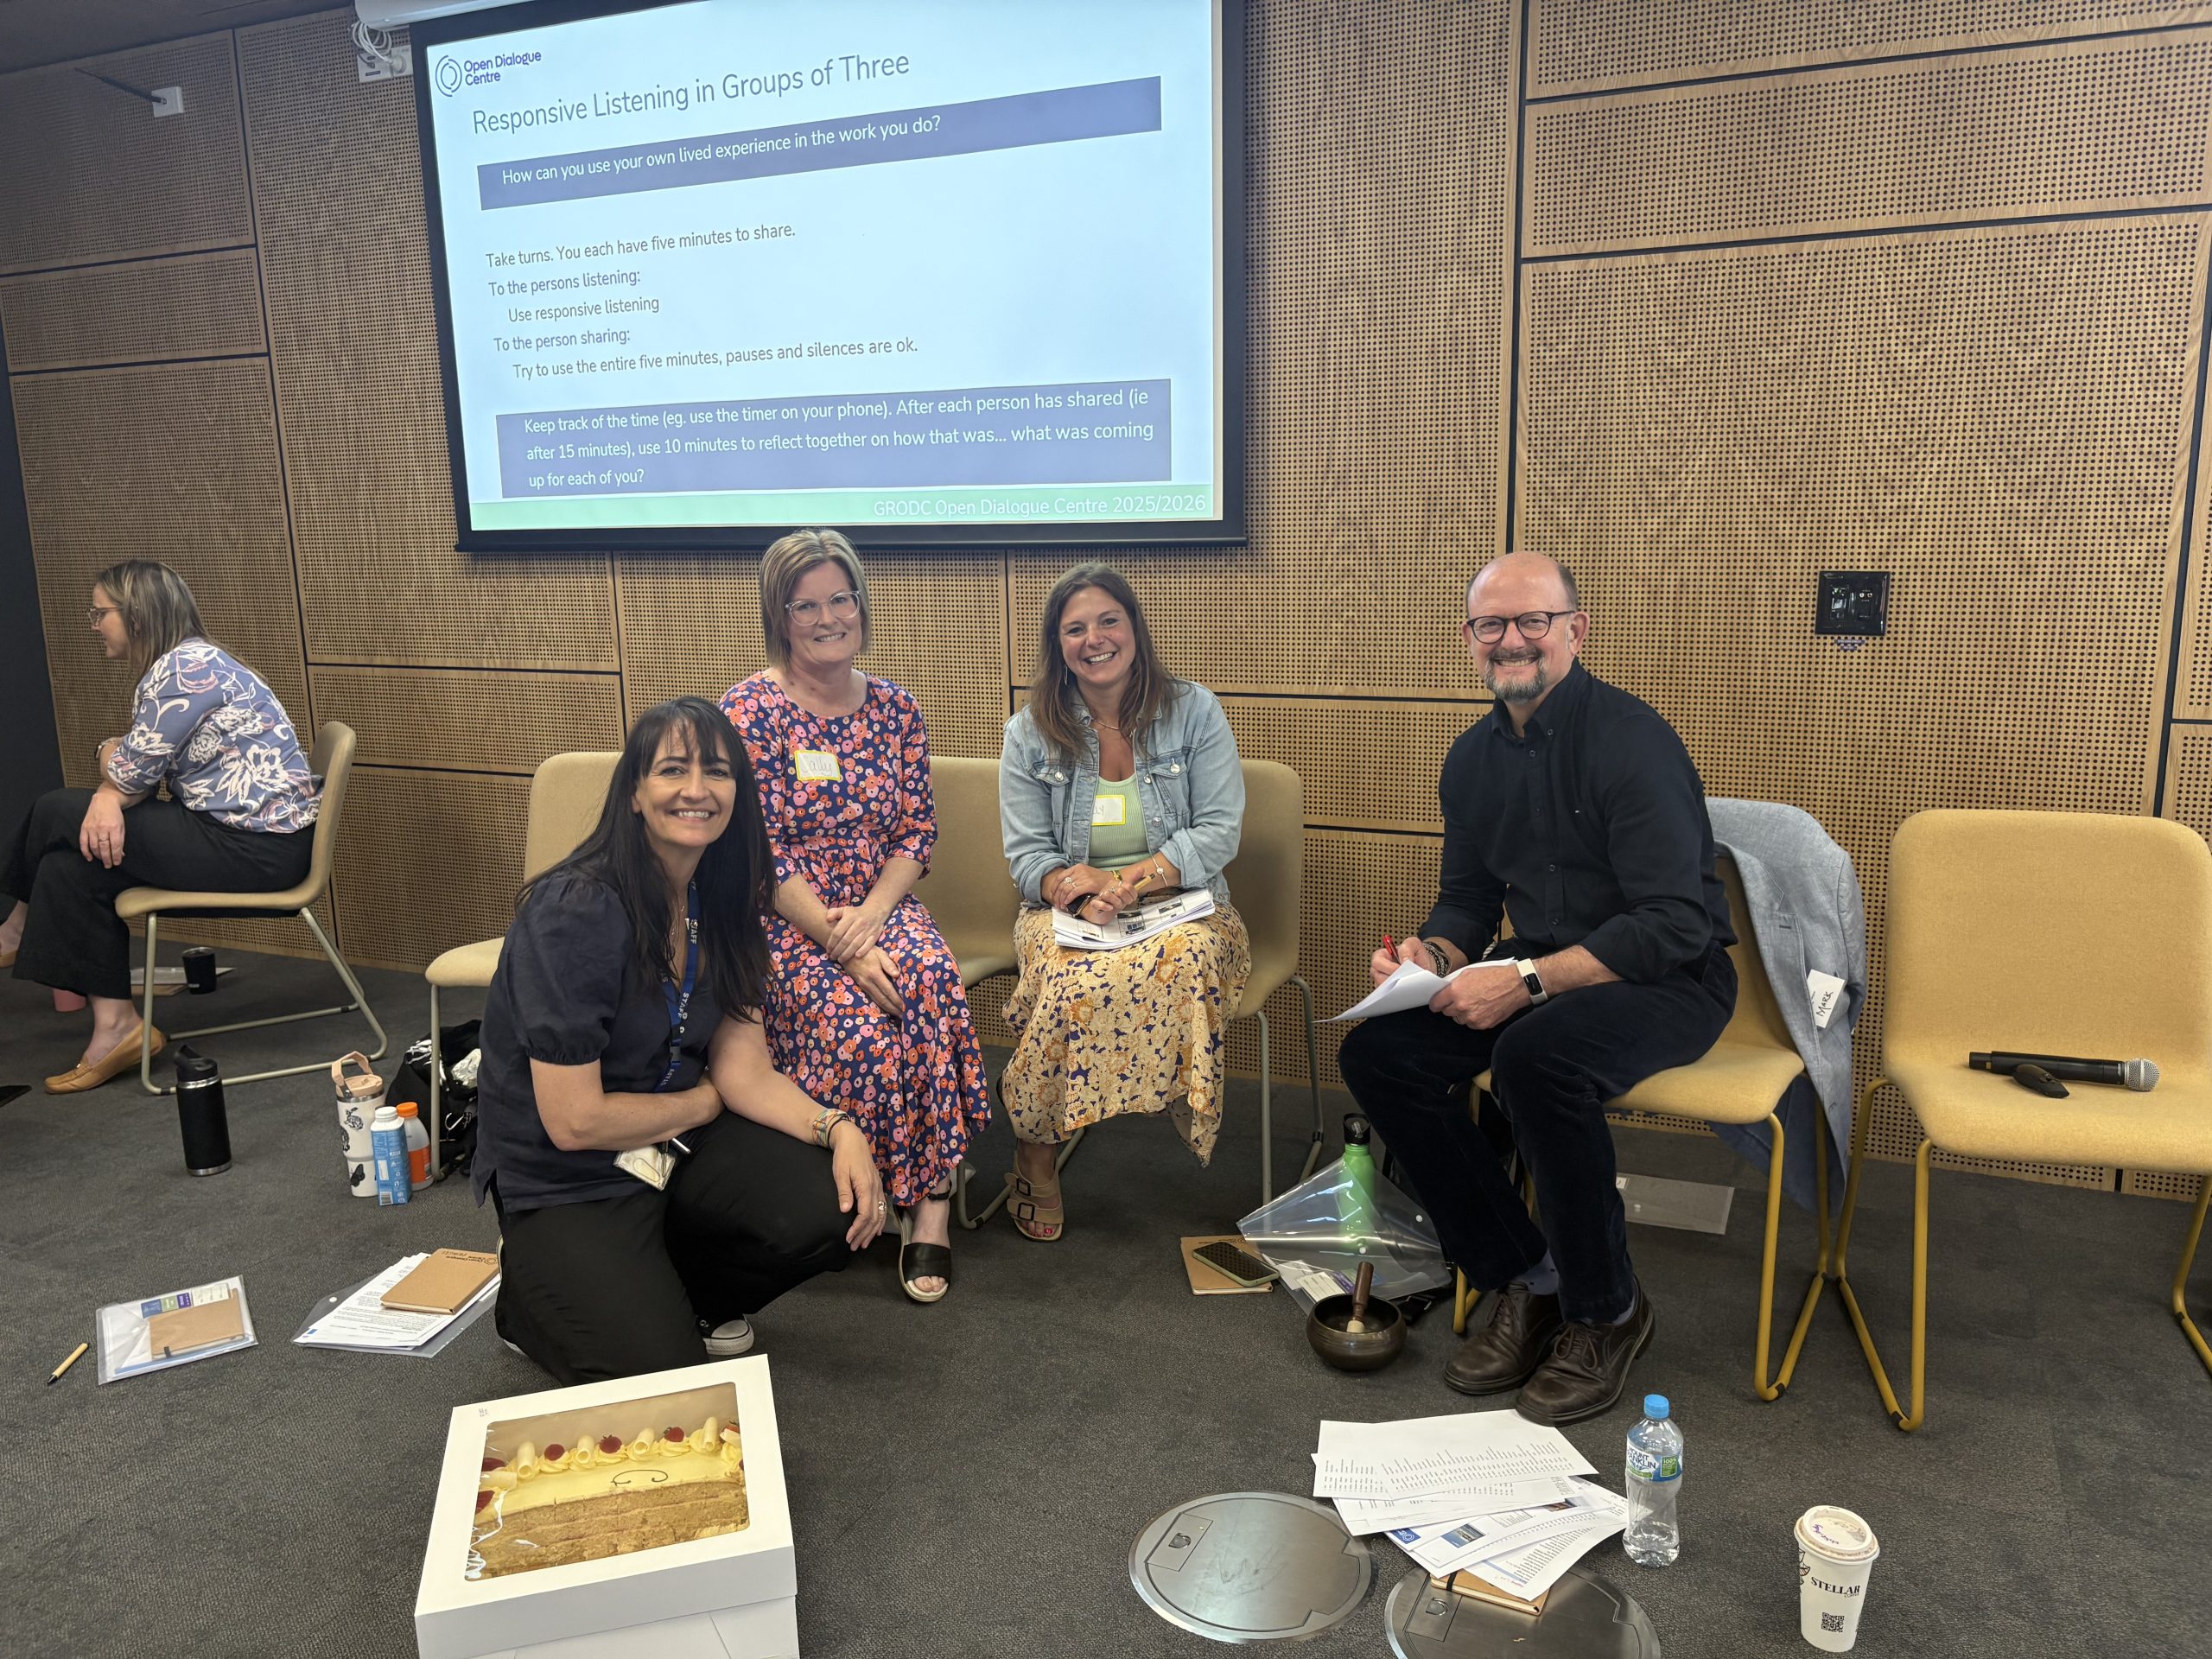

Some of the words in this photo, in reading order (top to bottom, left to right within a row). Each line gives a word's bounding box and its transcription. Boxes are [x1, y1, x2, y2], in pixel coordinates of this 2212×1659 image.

[464, 60, 493, 74] Open
[495, 50, 542, 67] Dialogue
[465, 71, 501, 86] Centre
[474, 99, 588, 134] Responsive
[594, 84, 689, 117] Listening
[696, 79, 715, 102] in
[722, 69, 804, 99] Groups
[811, 59, 834, 86] of
[838, 54, 910, 82] Three
[503, 168, 532, 185] How
[536, 168, 558, 180] can
[561, 164, 585, 181] you
[588, 161, 611, 173] use
[613, 156, 644, 175] your
[647, 152, 675, 166] own
[679, 144, 712, 163] lived
[715, 137, 791, 161] experience
[795, 132, 808, 149] in
[810, 129, 836, 145] the
[839, 123, 876, 143] work
[880, 121, 908, 142] you
[912, 115, 941, 133] do?
[486, 251, 516, 268] Take
[518, 251, 554, 264] turns.
[556, 245, 581, 261] You
[584, 241, 613, 258] each
[617, 239, 649, 255] have
[651, 235, 676, 251] five
[679, 230, 733, 248] minutes
[735, 227, 750, 243] to
[753, 223, 796, 240] share.
[488, 282, 505, 296] To
[507, 279, 528, 295] the
[531, 277, 580, 296] persons
[582, 270, 641, 288] listening:
[508, 308, 532, 323] Use
[536, 302, 602, 323] responsive
[605, 296, 660, 315] listening
[493, 338, 510, 353] To
[512, 335, 532, 351] the
[536, 334, 577, 353] person
[581, 328, 631, 346] sharing:
[512, 364, 533, 381] Try
[536, 363, 549, 378] to
[551, 362, 574, 376] use
[576, 359, 597, 374] the
[600, 355, 637, 372] entire
[639, 353, 663, 370] five
[666, 350, 722, 368] minutes,
[726, 349, 773, 366] pauses
[777, 343, 804, 359] and
[807, 341, 864, 358] silences
[868, 340, 893, 354] are
[896, 336, 918, 353] ok.
[524, 418, 556, 435] Keep
[557, 416, 588, 431] track
[591, 414, 605, 429] of
[607, 413, 628, 429] the
[630, 411, 659, 427] time
[663, 410, 687, 429] (eg.
[690, 410, 714, 423] use
[715, 407, 739, 422] the
[741, 406, 778, 422] timer
[781, 409, 798, 421] on
[802, 405, 834, 422] your
[837, 400, 893, 420] phone).
[896, 398, 934, 416] After
[938, 396, 972, 414] each
[976, 394, 1030, 415] person
[1034, 391, 1063, 410] has
[1067, 389, 1123, 408] shared
[1128, 389, 1148, 410] (ie
[526, 445, 555, 461] after
[559, 443, 575, 459] 15
[578, 441, 635, 458] minutes),
[639, 442, 661, 455] use
[664, 438, 681, 454] 10
[684, 436, 737, 453] minutes
[741, 436, 755, 451] to
[760, 434, 804, 450] reflect
[805, 432, 868, 451] together
[870, 433, 890, 448] on
[893, 429, 925, 446] how
[929, 427, 960, 444] that
[962, 427, 1007, 443] was...
[1011, 423, 1052, 442] what
[1055, 425, 1090, 441] was
[1093, 421, 1154, 442] coming
[529, 476, 544, 490] up
[547, 472, 564, 486] for
[568, 471, 596, 486] each
[600, 469, 613, 485] of
[614, 468, 645, 486] you?
[873, 499, 931, 518] GRODC
[936, 499, 976, 518] Open
[980, 496, 1051, 519] Dialogue
[1054, 496, 1108, 514] Centre
[1112, 493, 1206, 513] 2025/2026
[1811, 1577, 1860, 1594] STELLAR
